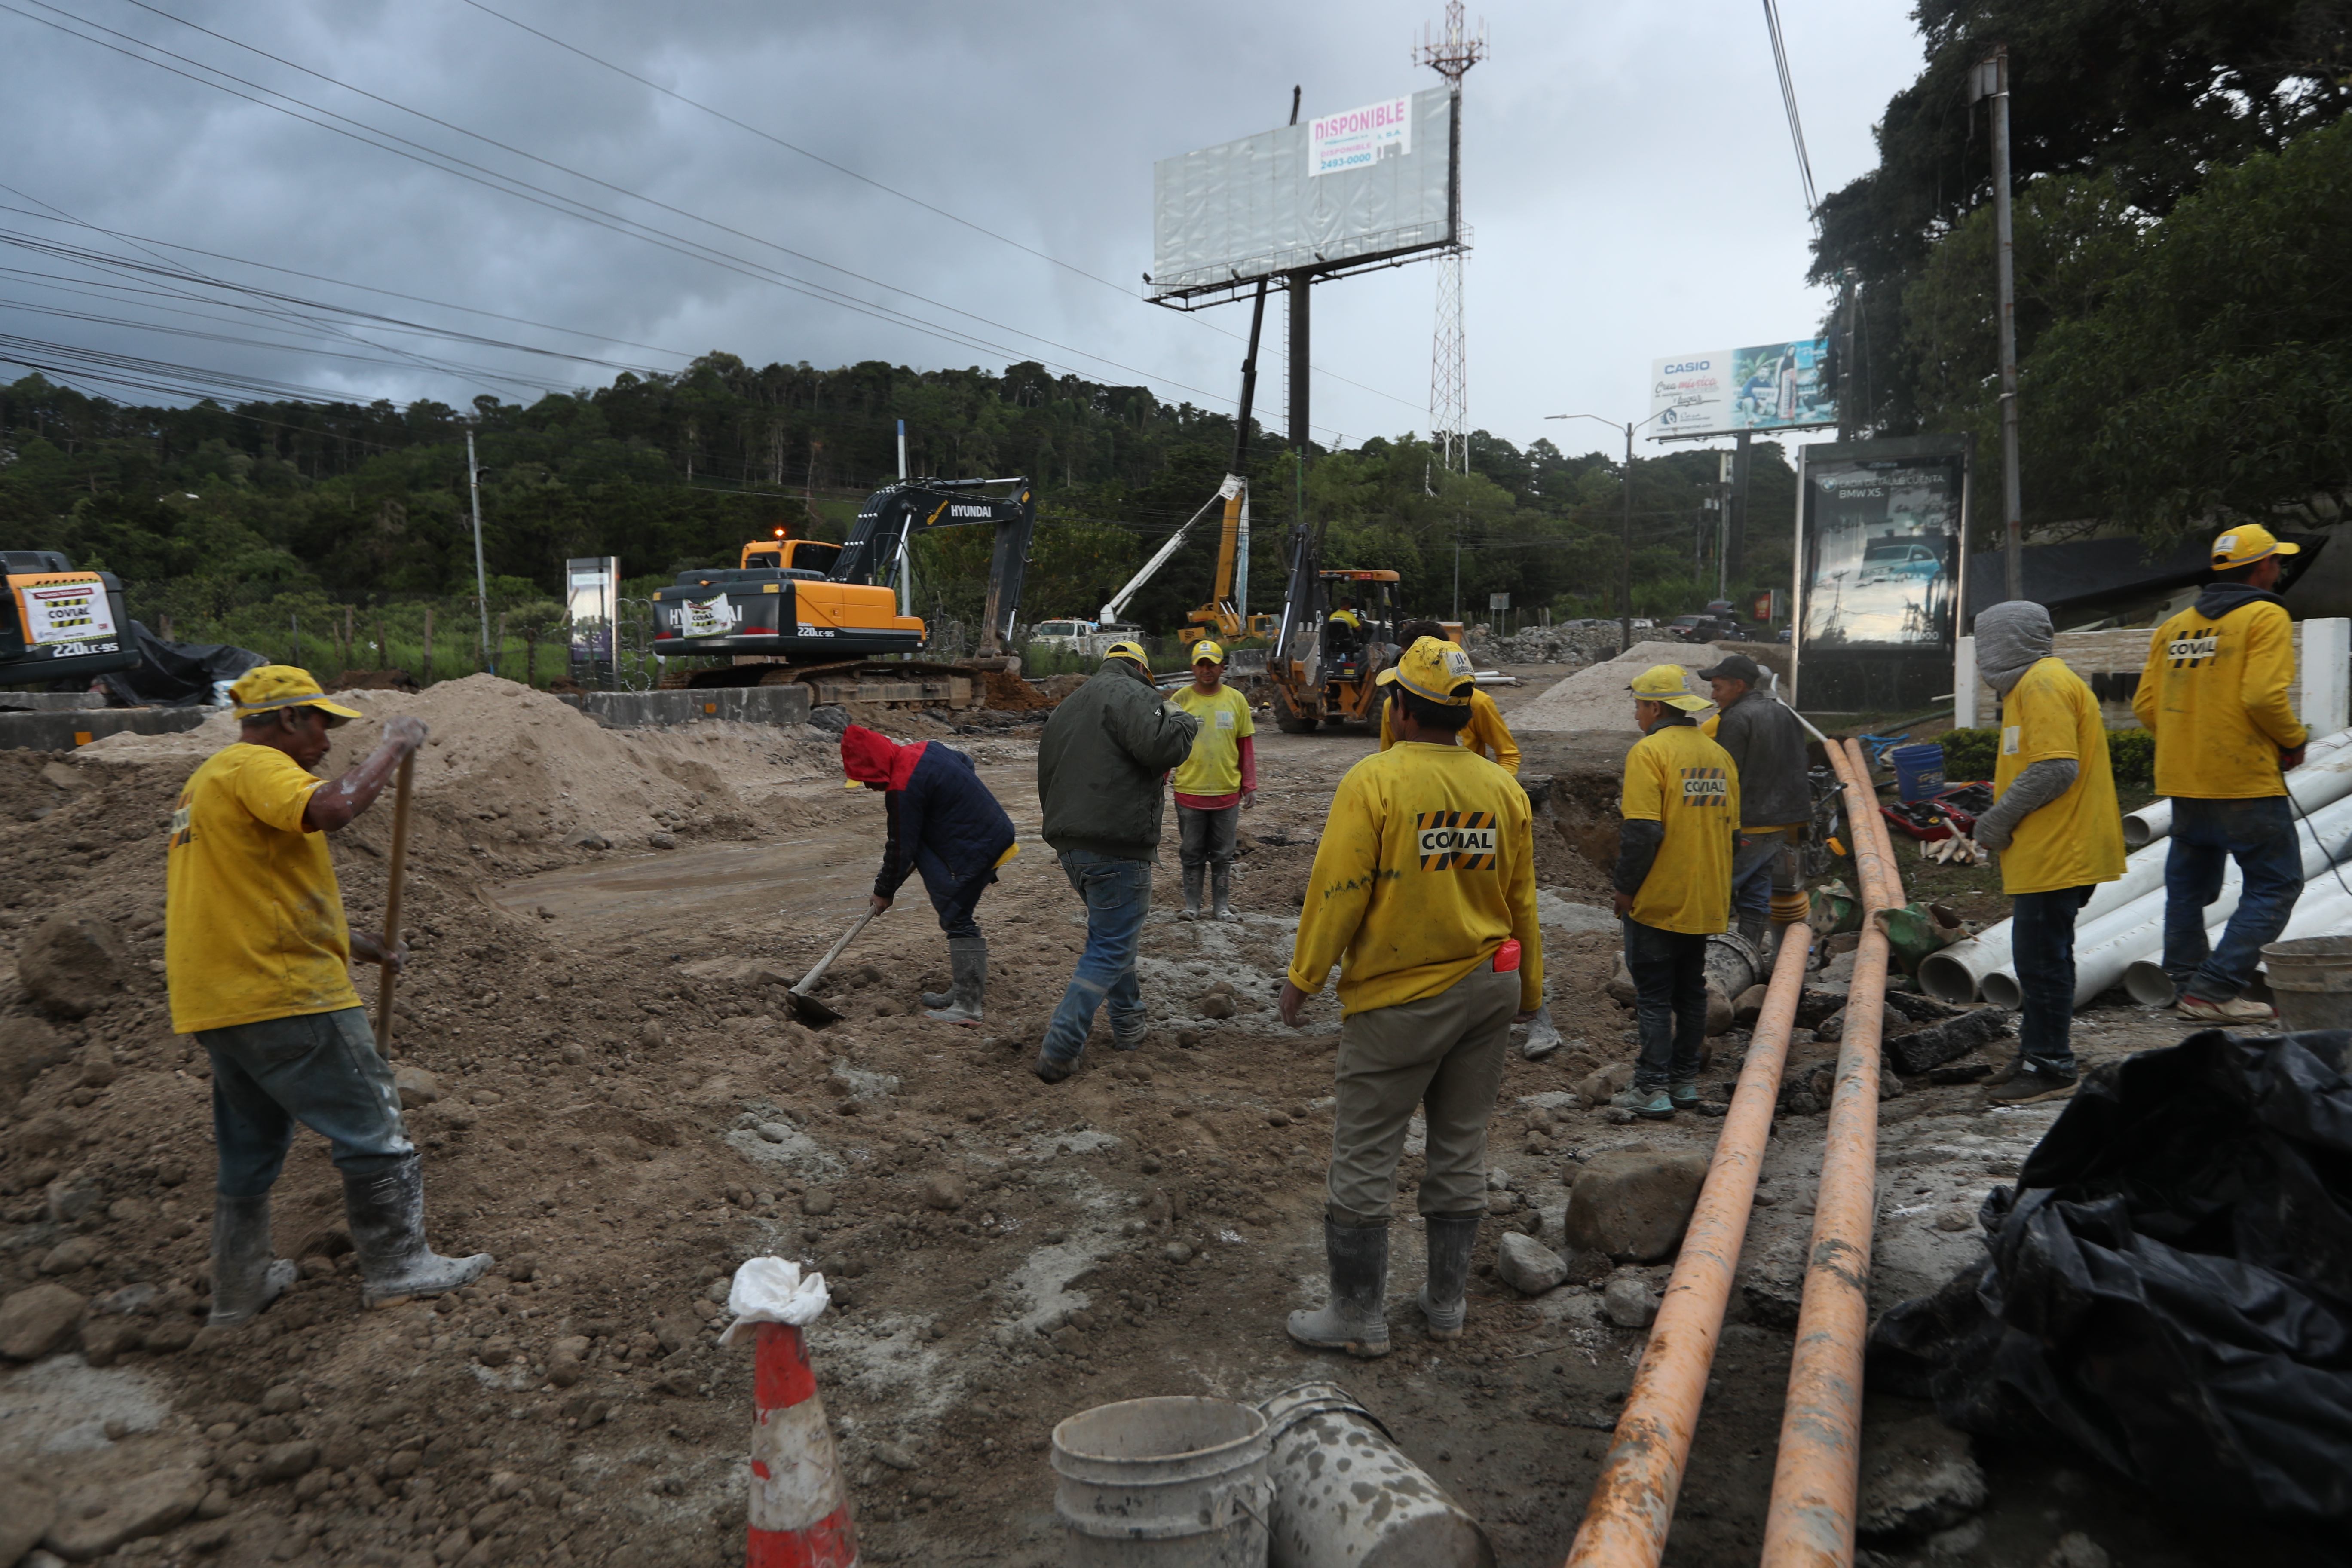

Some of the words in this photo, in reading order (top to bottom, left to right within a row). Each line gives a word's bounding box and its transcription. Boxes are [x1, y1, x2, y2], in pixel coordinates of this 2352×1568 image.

[1315, 101, 1404, 142] DISPONIBLE
[1320, 141, 1372, 158] DISPONIBLE
[1320, 153, 1371, 169] 2493-0000
[1664, 360, 1710, 374] CASIO
[1865, 477, 1905, 486] DETALLE
[1838, 489, 1866, 499] BMW
[950, 505, 992, 517] HYUNDAI
[48, 607, 91, 618] COVIAL
[1422, 831, 1493, 850] COVIAL
